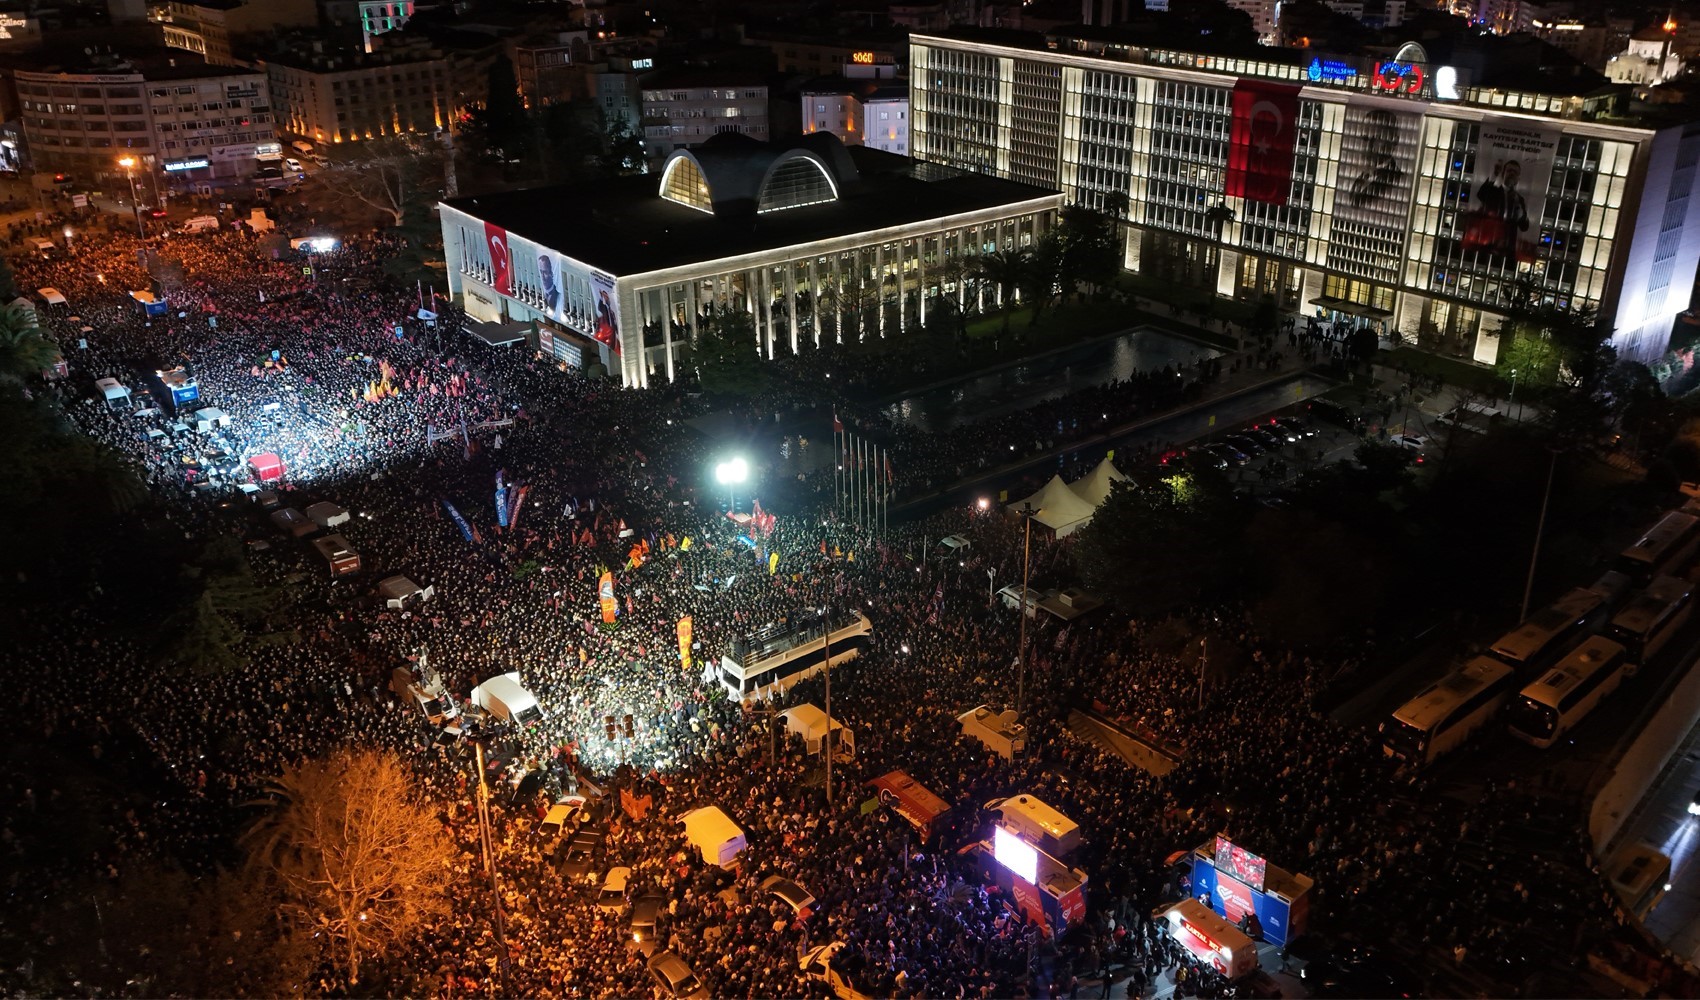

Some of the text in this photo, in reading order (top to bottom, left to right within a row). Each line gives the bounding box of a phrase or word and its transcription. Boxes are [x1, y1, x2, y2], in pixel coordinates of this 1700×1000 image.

[1496, 127, 1541, 139] EGEMENLİK
[1482, 133, 1555, 149] KAYITSIZ ŞARTSIZ
[1492, 142, 1542, 154] MİLLETİNDİR
[1185, 923, 1208, 944] KARTAL
